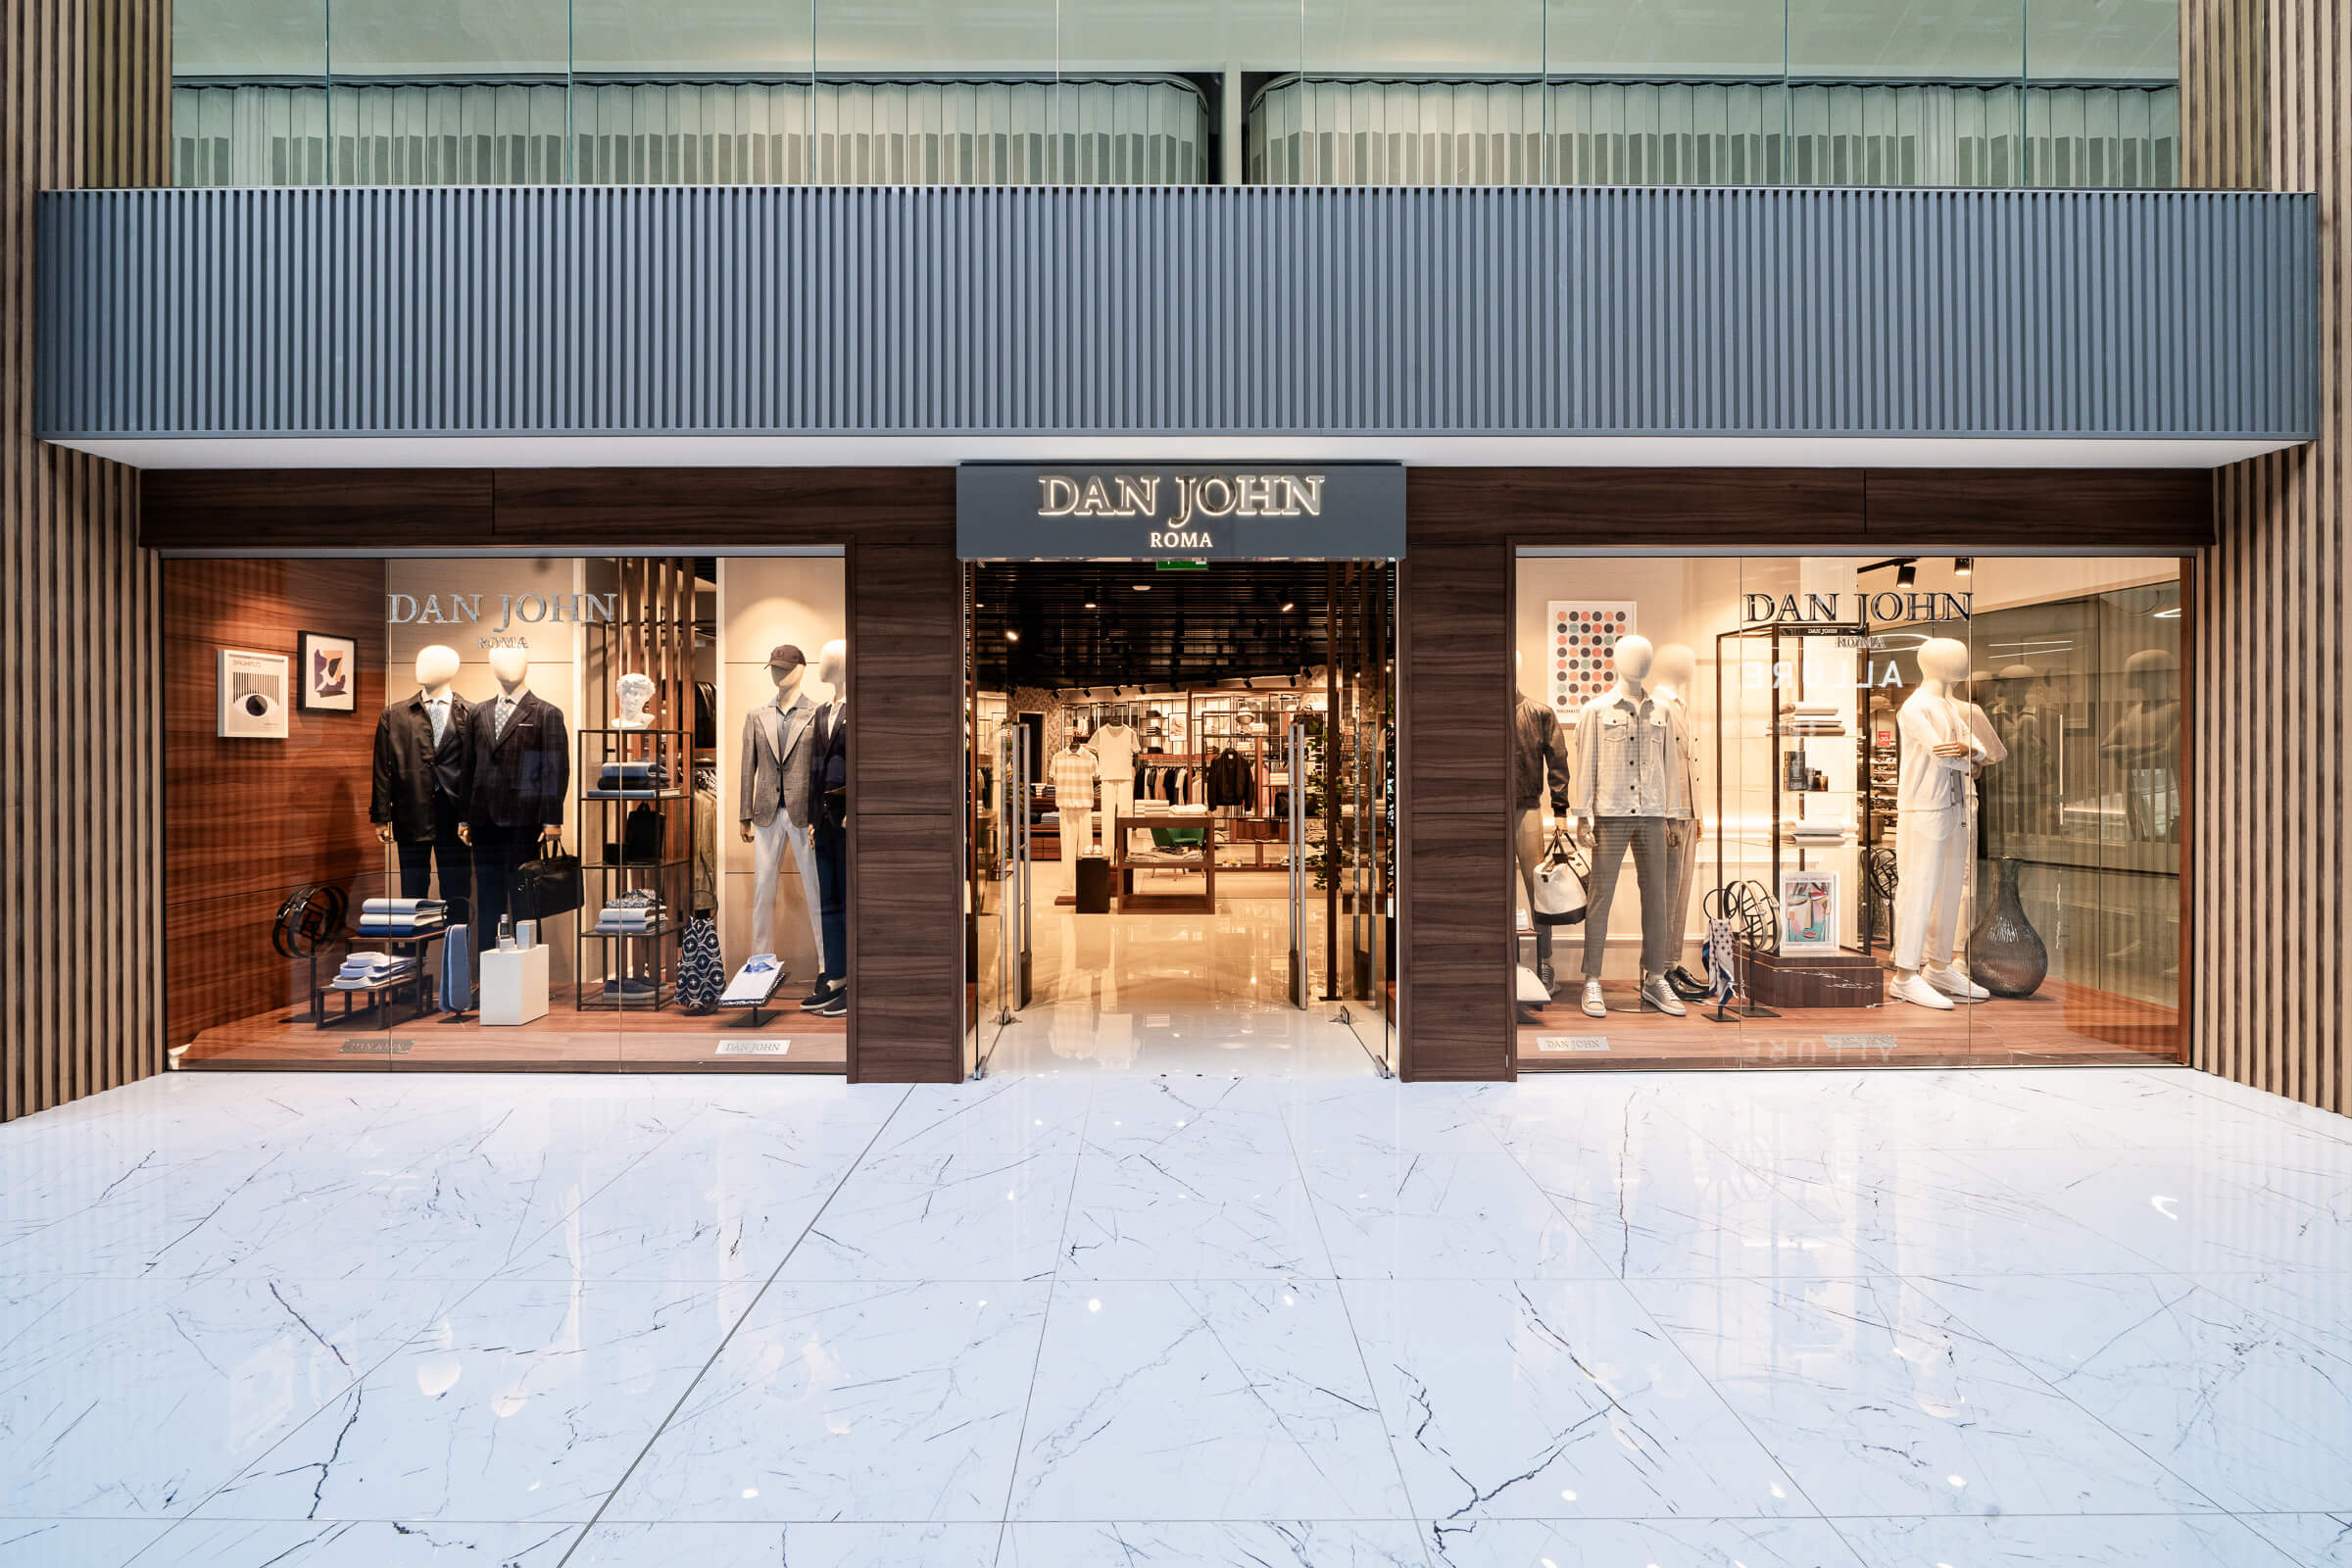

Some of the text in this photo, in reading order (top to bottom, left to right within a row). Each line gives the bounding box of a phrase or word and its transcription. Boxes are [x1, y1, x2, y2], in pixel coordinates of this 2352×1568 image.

[1038, 475, 1325, 528] DAN JOHN
[1150, 532, 1213, 548] ROMA
[387, 593, 617, 633] DAN JOHN
[1743, 591, 1974, 633] DAN JOHN
[477, 636, 529, 649] ROMA
[1837, 635, 1886, 649] ROMA
[725, 1042, 781, 1054] DAN JOHN
[1545, 1040, 1599, 1052] DAN JOHN
